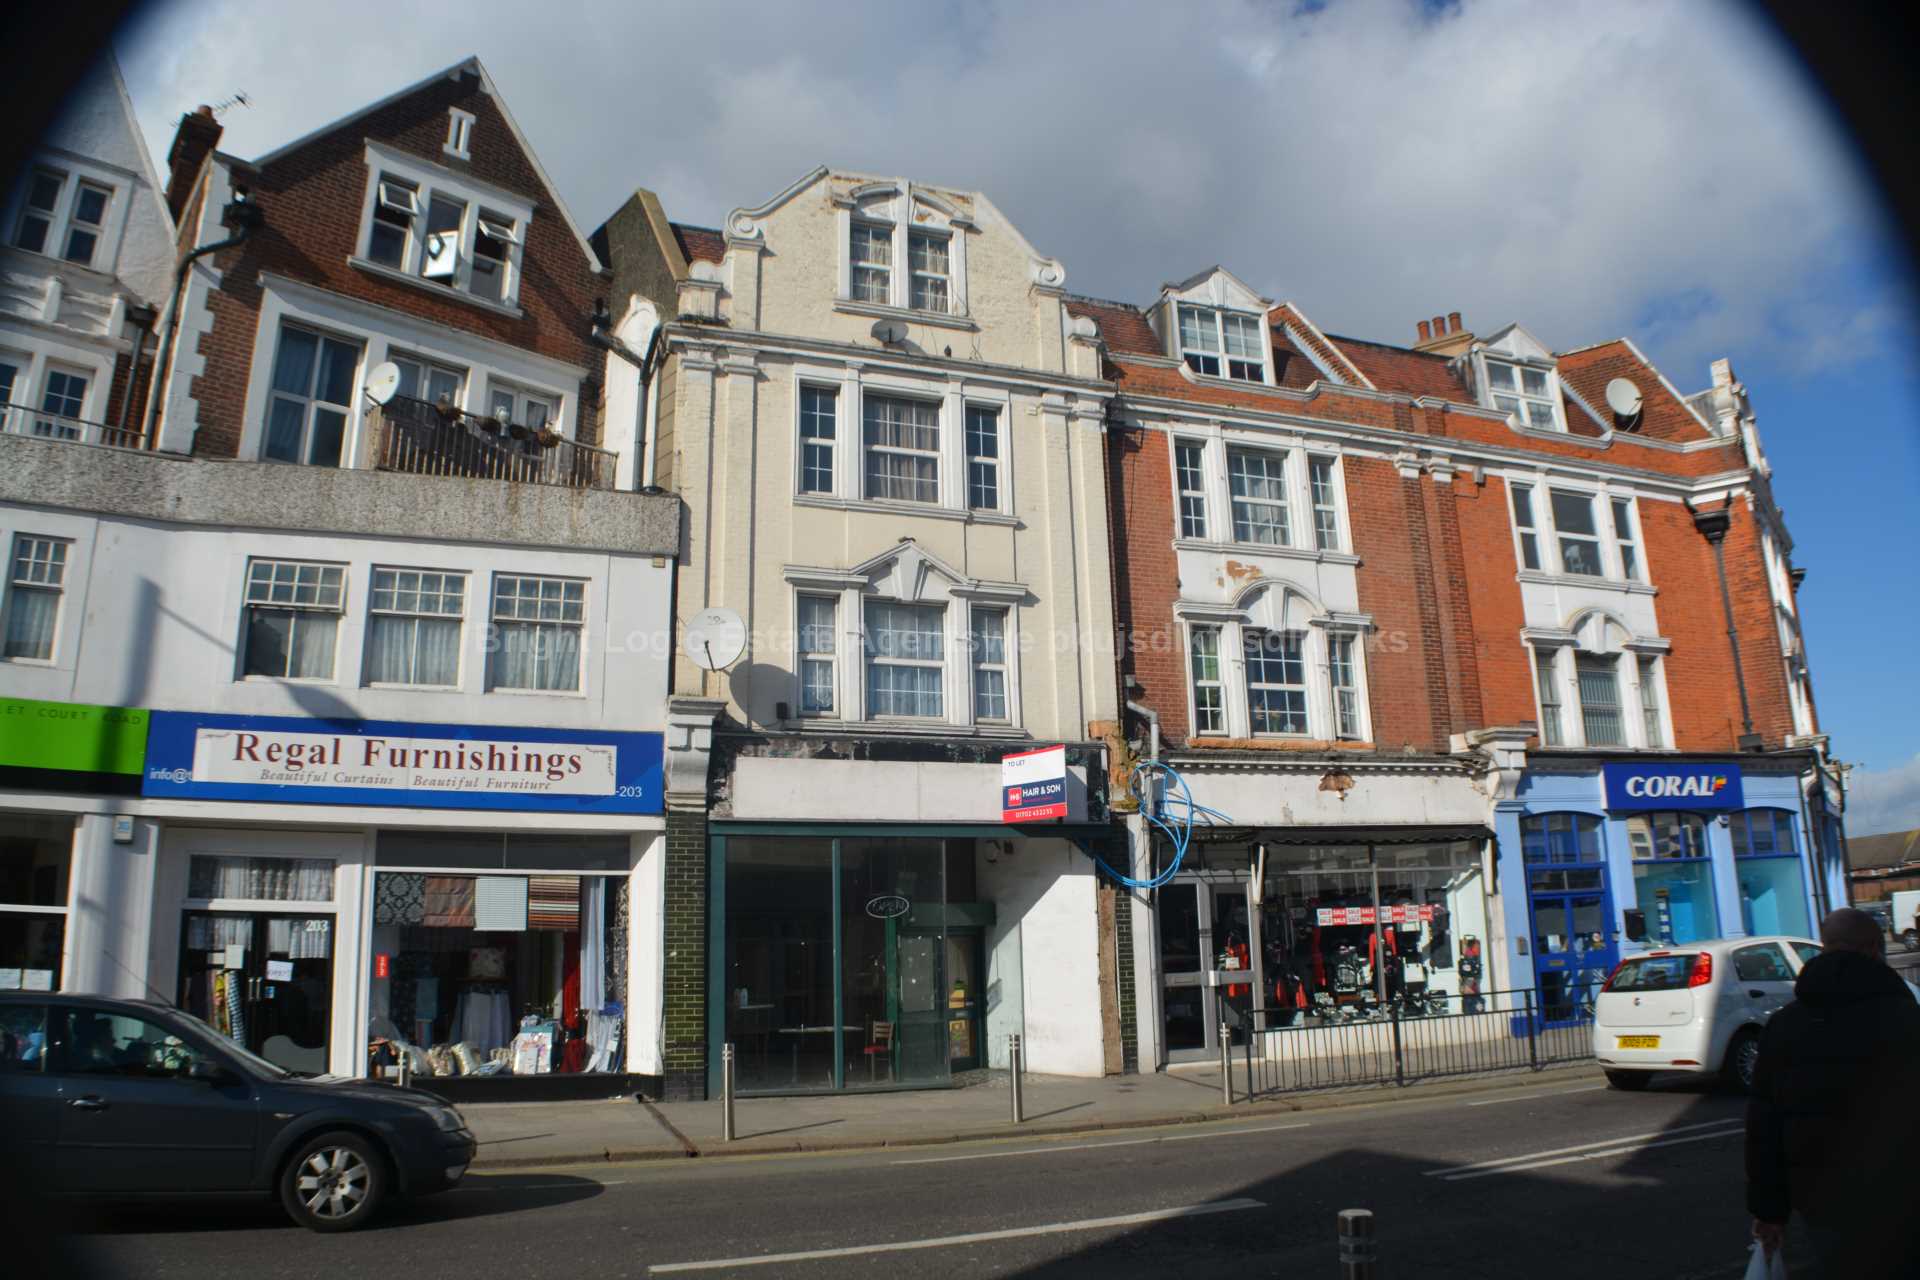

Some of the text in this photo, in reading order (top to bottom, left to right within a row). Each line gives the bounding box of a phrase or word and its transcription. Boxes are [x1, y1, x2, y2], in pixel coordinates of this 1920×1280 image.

[233, 733, 582, 781] Regal Furnishings
[260, 769, 552, 791] Beautiful Curtains Beautiful Furniture
[1625, 776, 1714, 797] CORAL
[1022, 784, 1061, 798] HAIR & SON
[305, 919, 329, 931] 203
